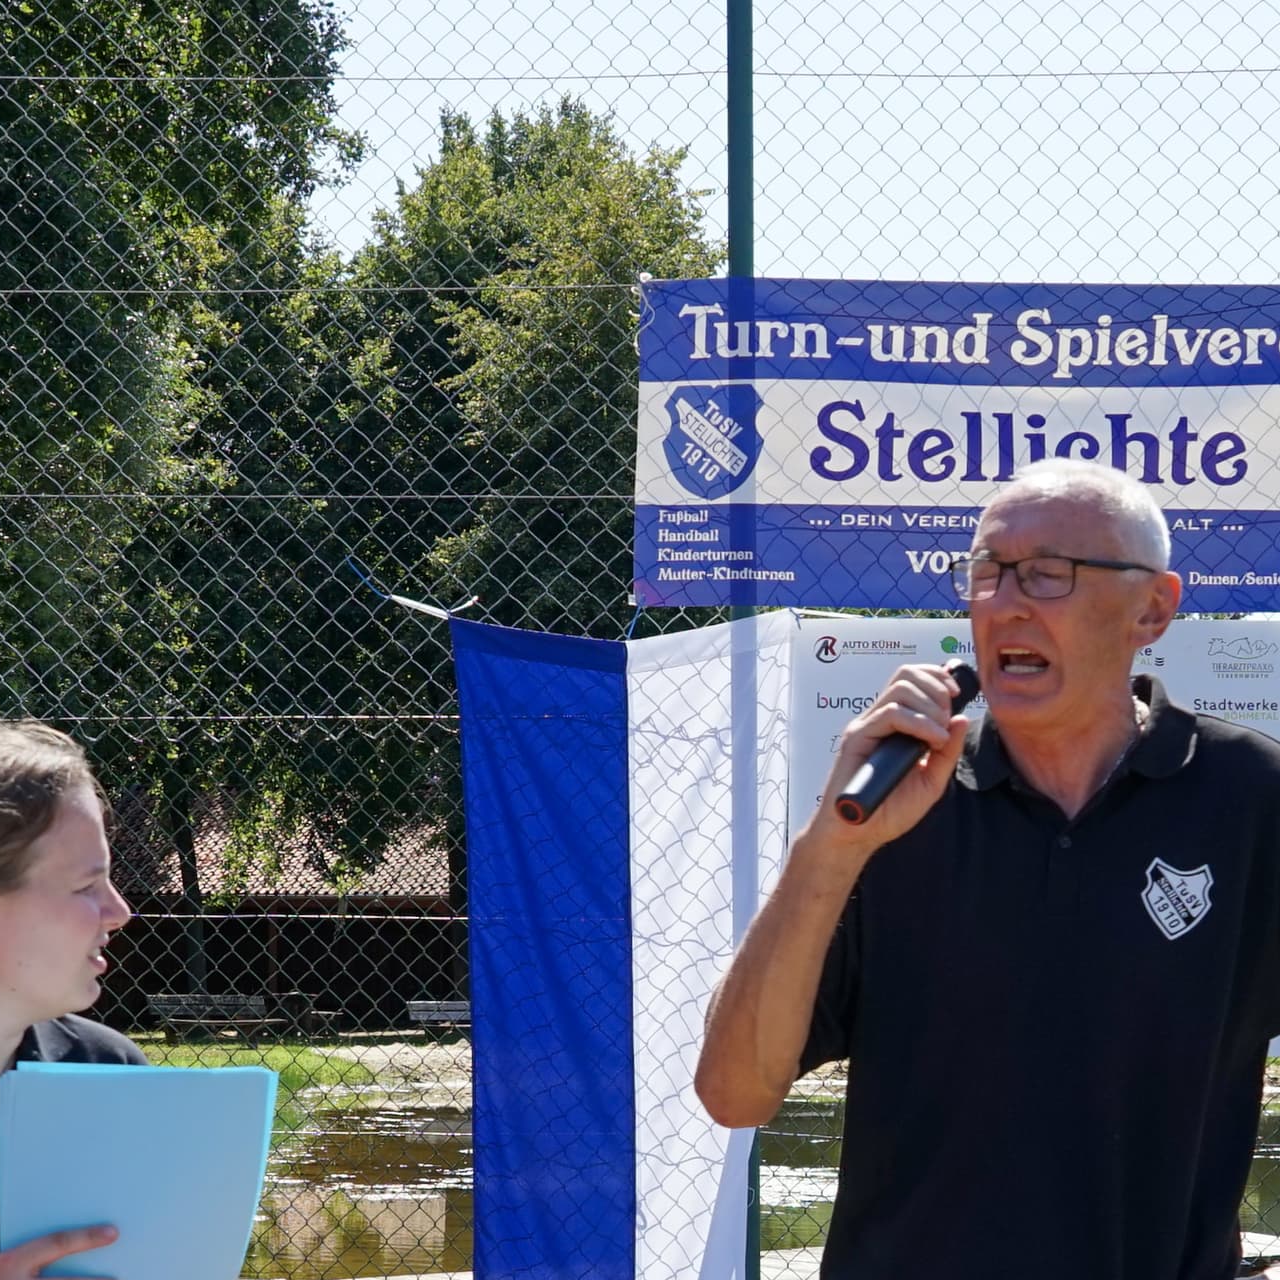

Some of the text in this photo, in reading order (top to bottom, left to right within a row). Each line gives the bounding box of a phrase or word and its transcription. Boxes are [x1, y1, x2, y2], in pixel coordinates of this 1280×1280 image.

[678, 303, 993, 365] Turn-und
[681, 412, 745, 473] STELLICHTE
[809, 399, 1248, 485] Stellichte
[680, 442, 721, 482] 1910
[658, 509, 709, 527] Fußball
[840, 513, 893, 527] DEIN
[657, 528, 719, 543] Handball
[657, 548, 754, 562] Kinderturnen
[657, 566, 795, 582] Mutter-Kindturnen
[842, 640, 870, 649] AUTO
[871, 639, 901, 650] KÜHN
[1193, 698, 1279, 711] Stadtwerke
[1176, 879, 1203, 910] TuSV
[1153, 895, 1181, 929] 1910
